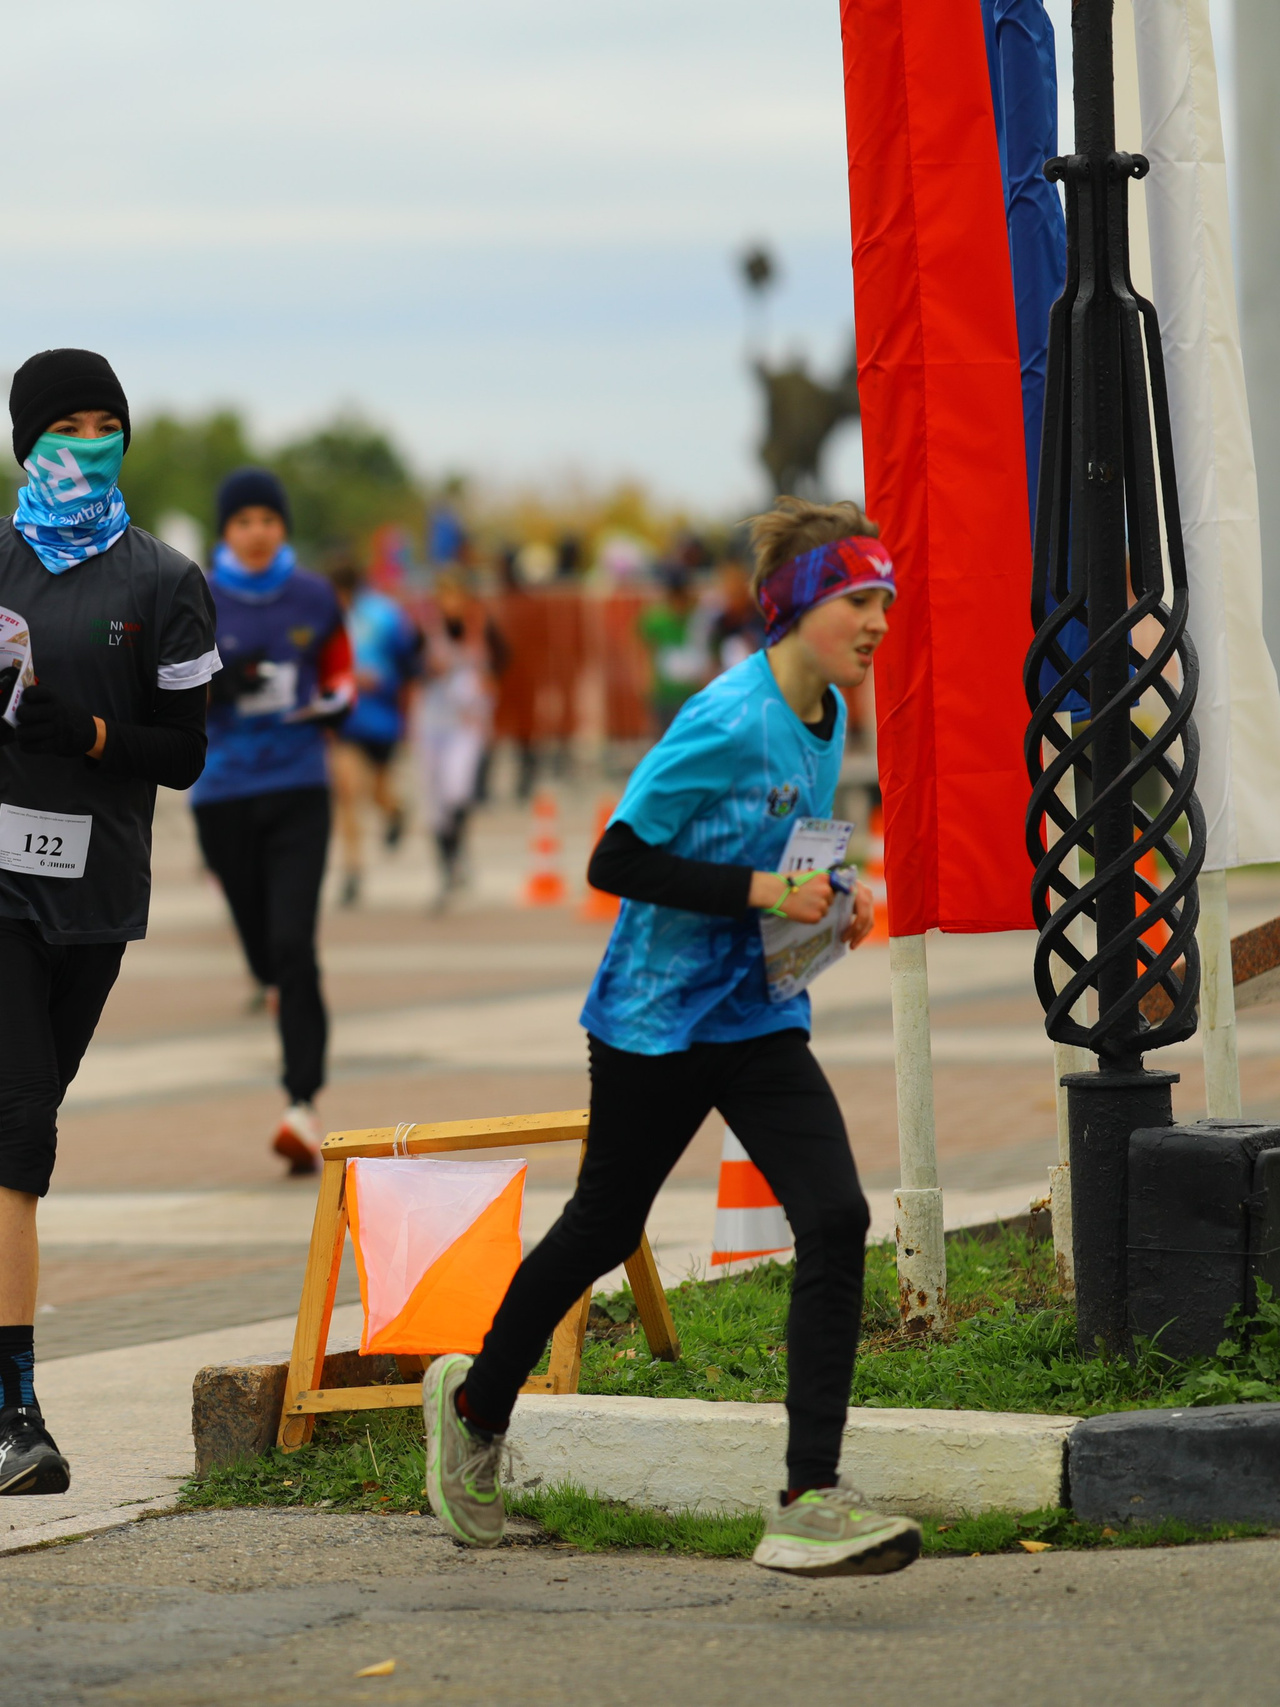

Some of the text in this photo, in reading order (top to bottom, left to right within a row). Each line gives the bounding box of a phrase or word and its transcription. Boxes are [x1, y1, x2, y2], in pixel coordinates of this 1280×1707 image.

[23, 833, 63, 856] 122
[40, 859, 45, 867] 6
[47, 861, 75, 869] линия
